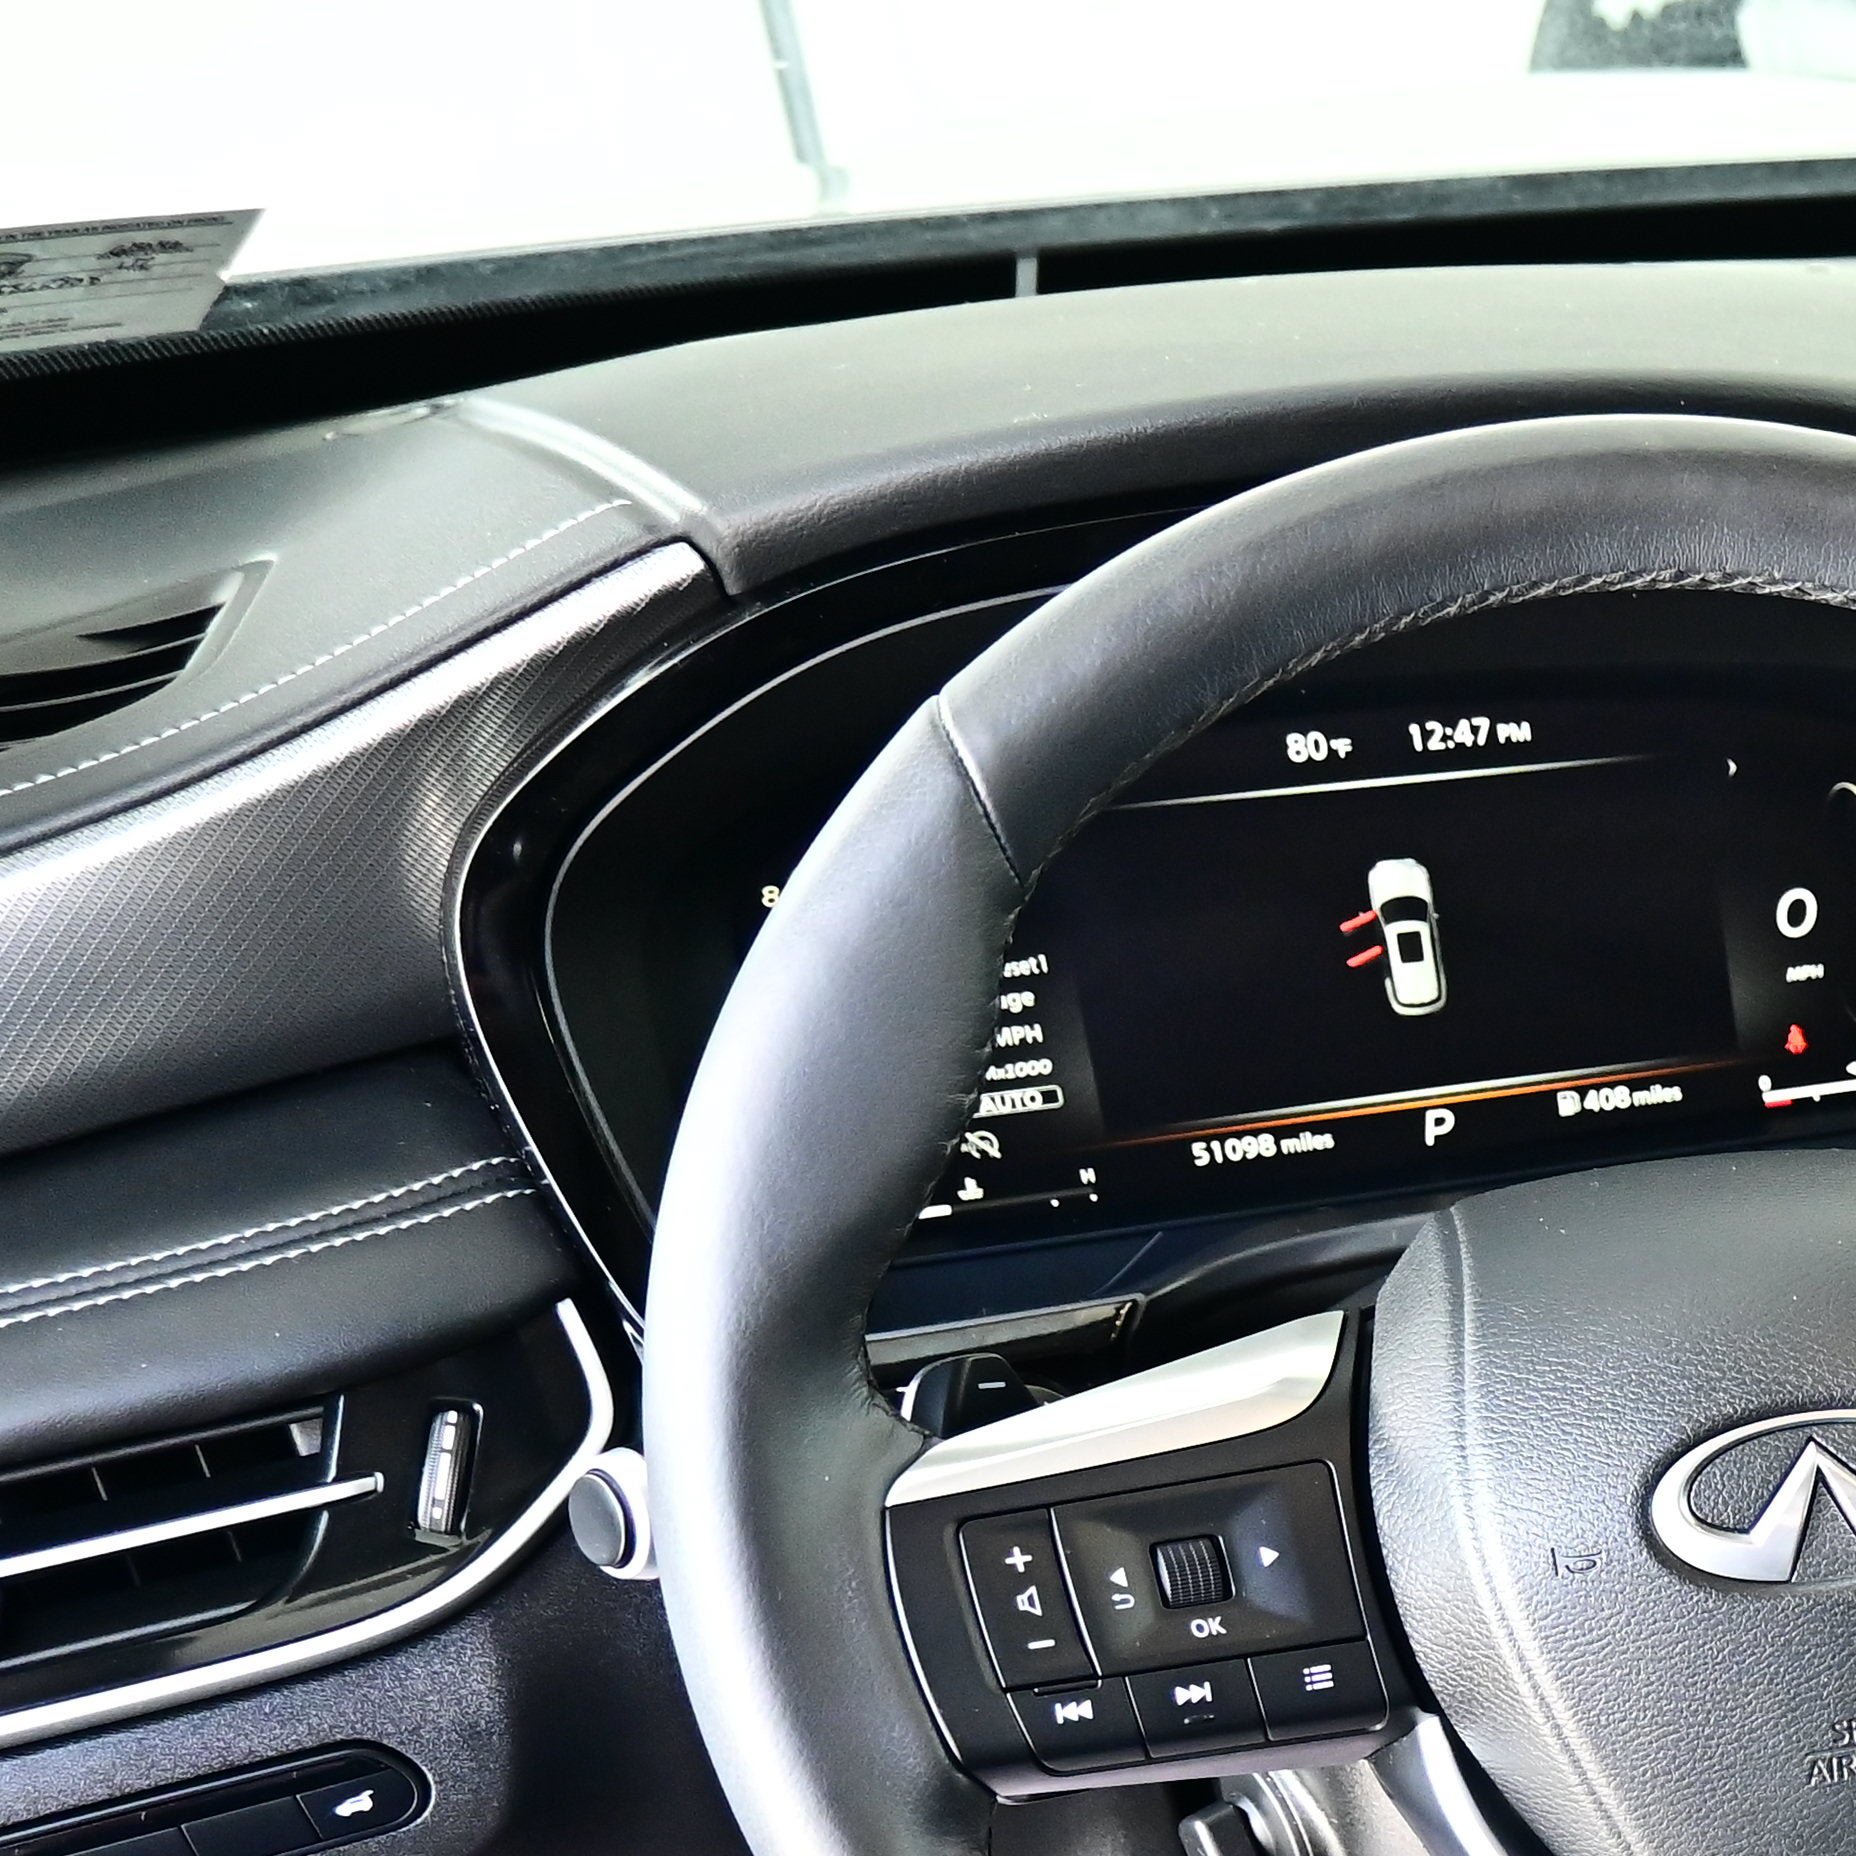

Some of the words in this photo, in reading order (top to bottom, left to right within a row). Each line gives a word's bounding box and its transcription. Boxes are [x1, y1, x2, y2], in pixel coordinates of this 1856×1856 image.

[1408, 716, 1491, 752] 12:47
[1496, 721, 1532, 745] PM
[1775, 886, 1818, 938] 0
[980, 1089, 1044, 1115] AUTO
[1582, 1085, 1633, 1112] 408
[1632, 1084, 1683, 1108] miles
[1424, 1109, 1456, 1147] P
[1191, 1133, 1278, 1167] 51098
[1280, 1131, 1335, 1157] miles
[1190, 1615, 1227, 1640] OK
